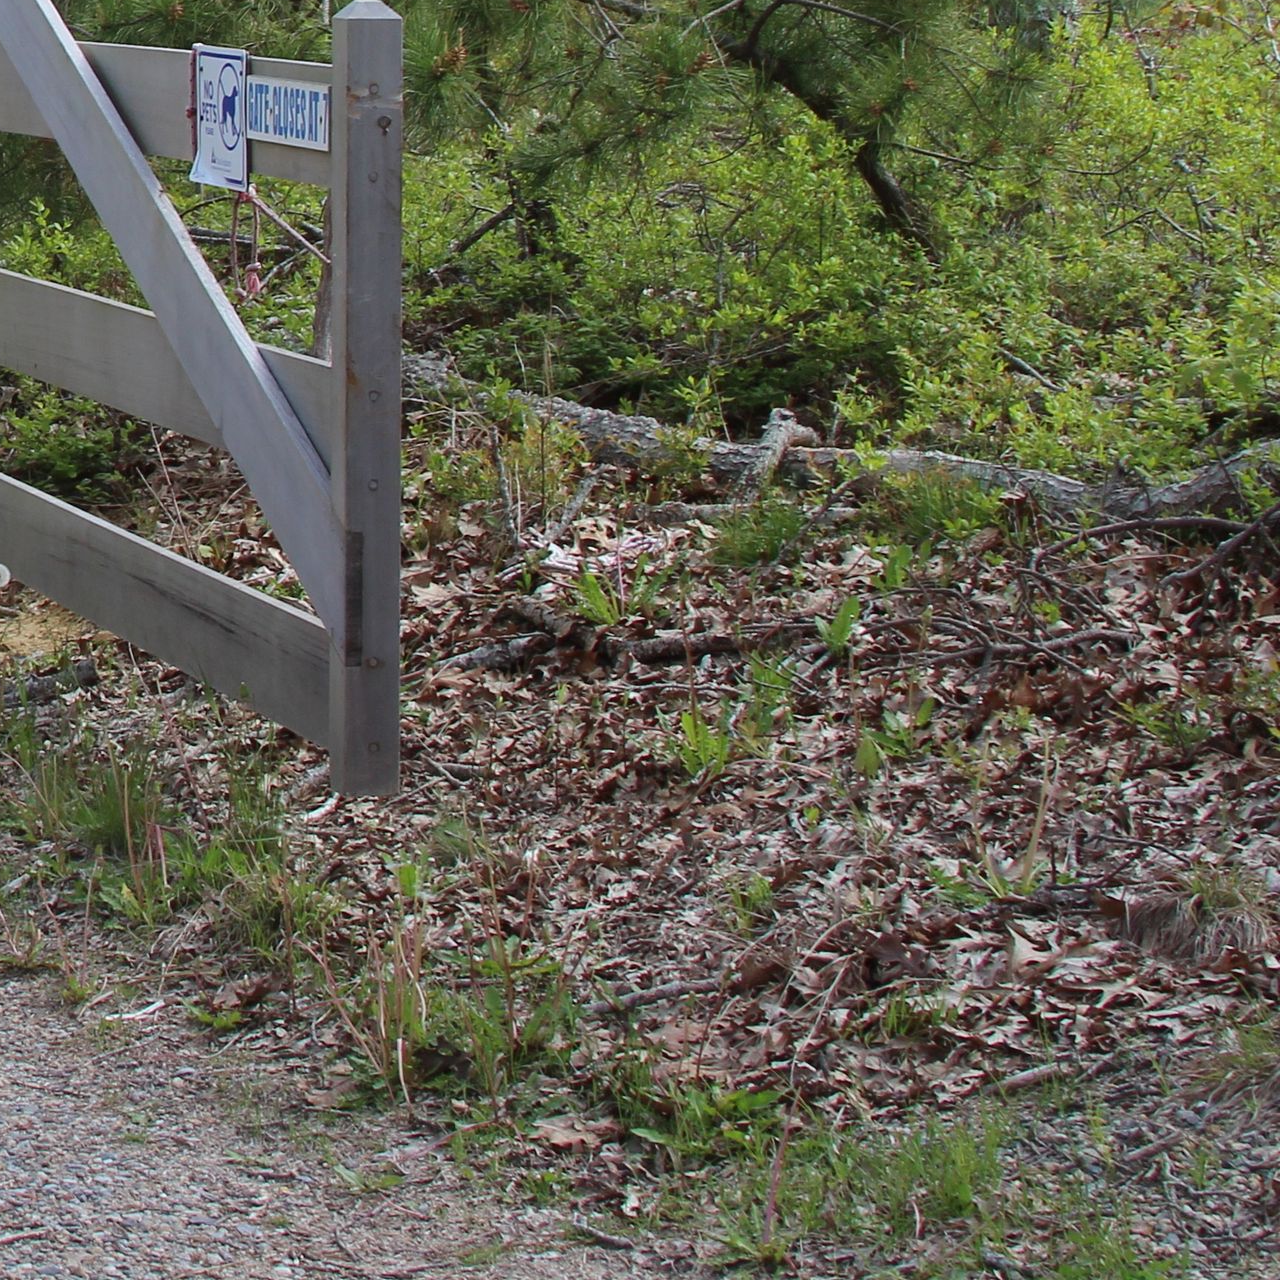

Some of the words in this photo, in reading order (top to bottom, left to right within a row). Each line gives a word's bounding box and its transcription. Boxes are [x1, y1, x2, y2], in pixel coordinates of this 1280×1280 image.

[203, 80, 214, 100] NO
[202, 102, 217, 123] PETS
[249, 82, 269, 133] GATE
[273, 86, 306, 140] CLOSES
[308, 90, 319, 142] AT
